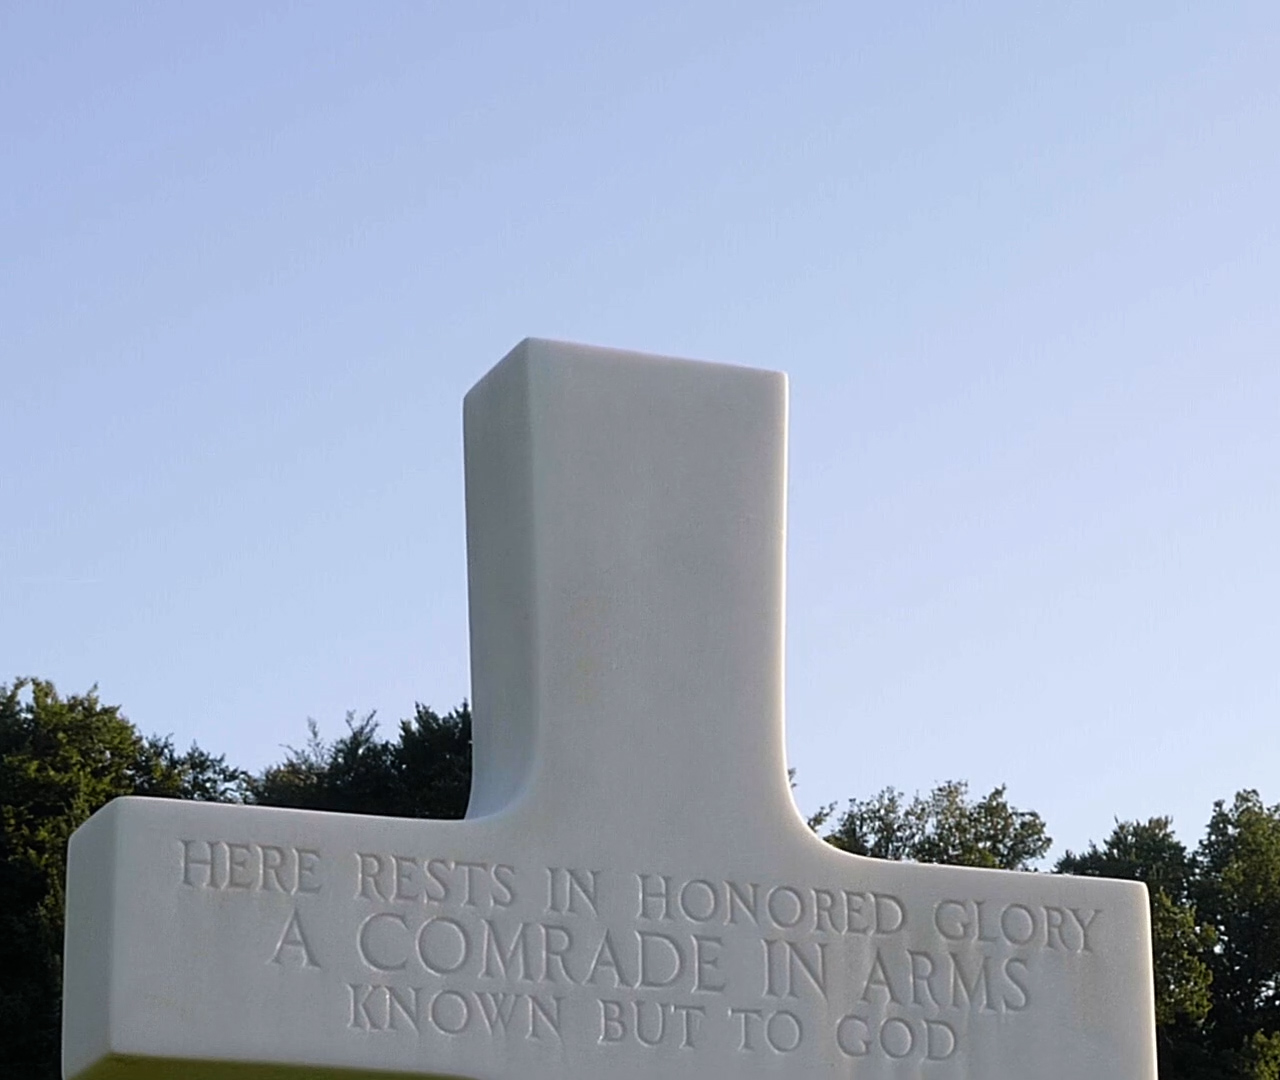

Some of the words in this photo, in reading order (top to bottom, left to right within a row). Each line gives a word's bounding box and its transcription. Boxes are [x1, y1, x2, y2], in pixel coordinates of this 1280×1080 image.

[178, 838, 323, 895] HERE
[354, 852, 517, 908] RESTS
[546, 867, 601, 914] IN
[636, 874, 907, 935] HONORED
[933, 898, 1104, 956] GLORY
[270, 908, 321, 968] A
[356, 913, 725, 994] COMRADE
[760, 938, 832, 1002] IN
[862, 948, 1032, 1011] ARMS
[346, 983, 563, 1041] KNOWN
[597, 1000, 702, 1050] BUT
[728, 1007, 805, 1054] TO
[835, 1017, 960, 1061] GOD
